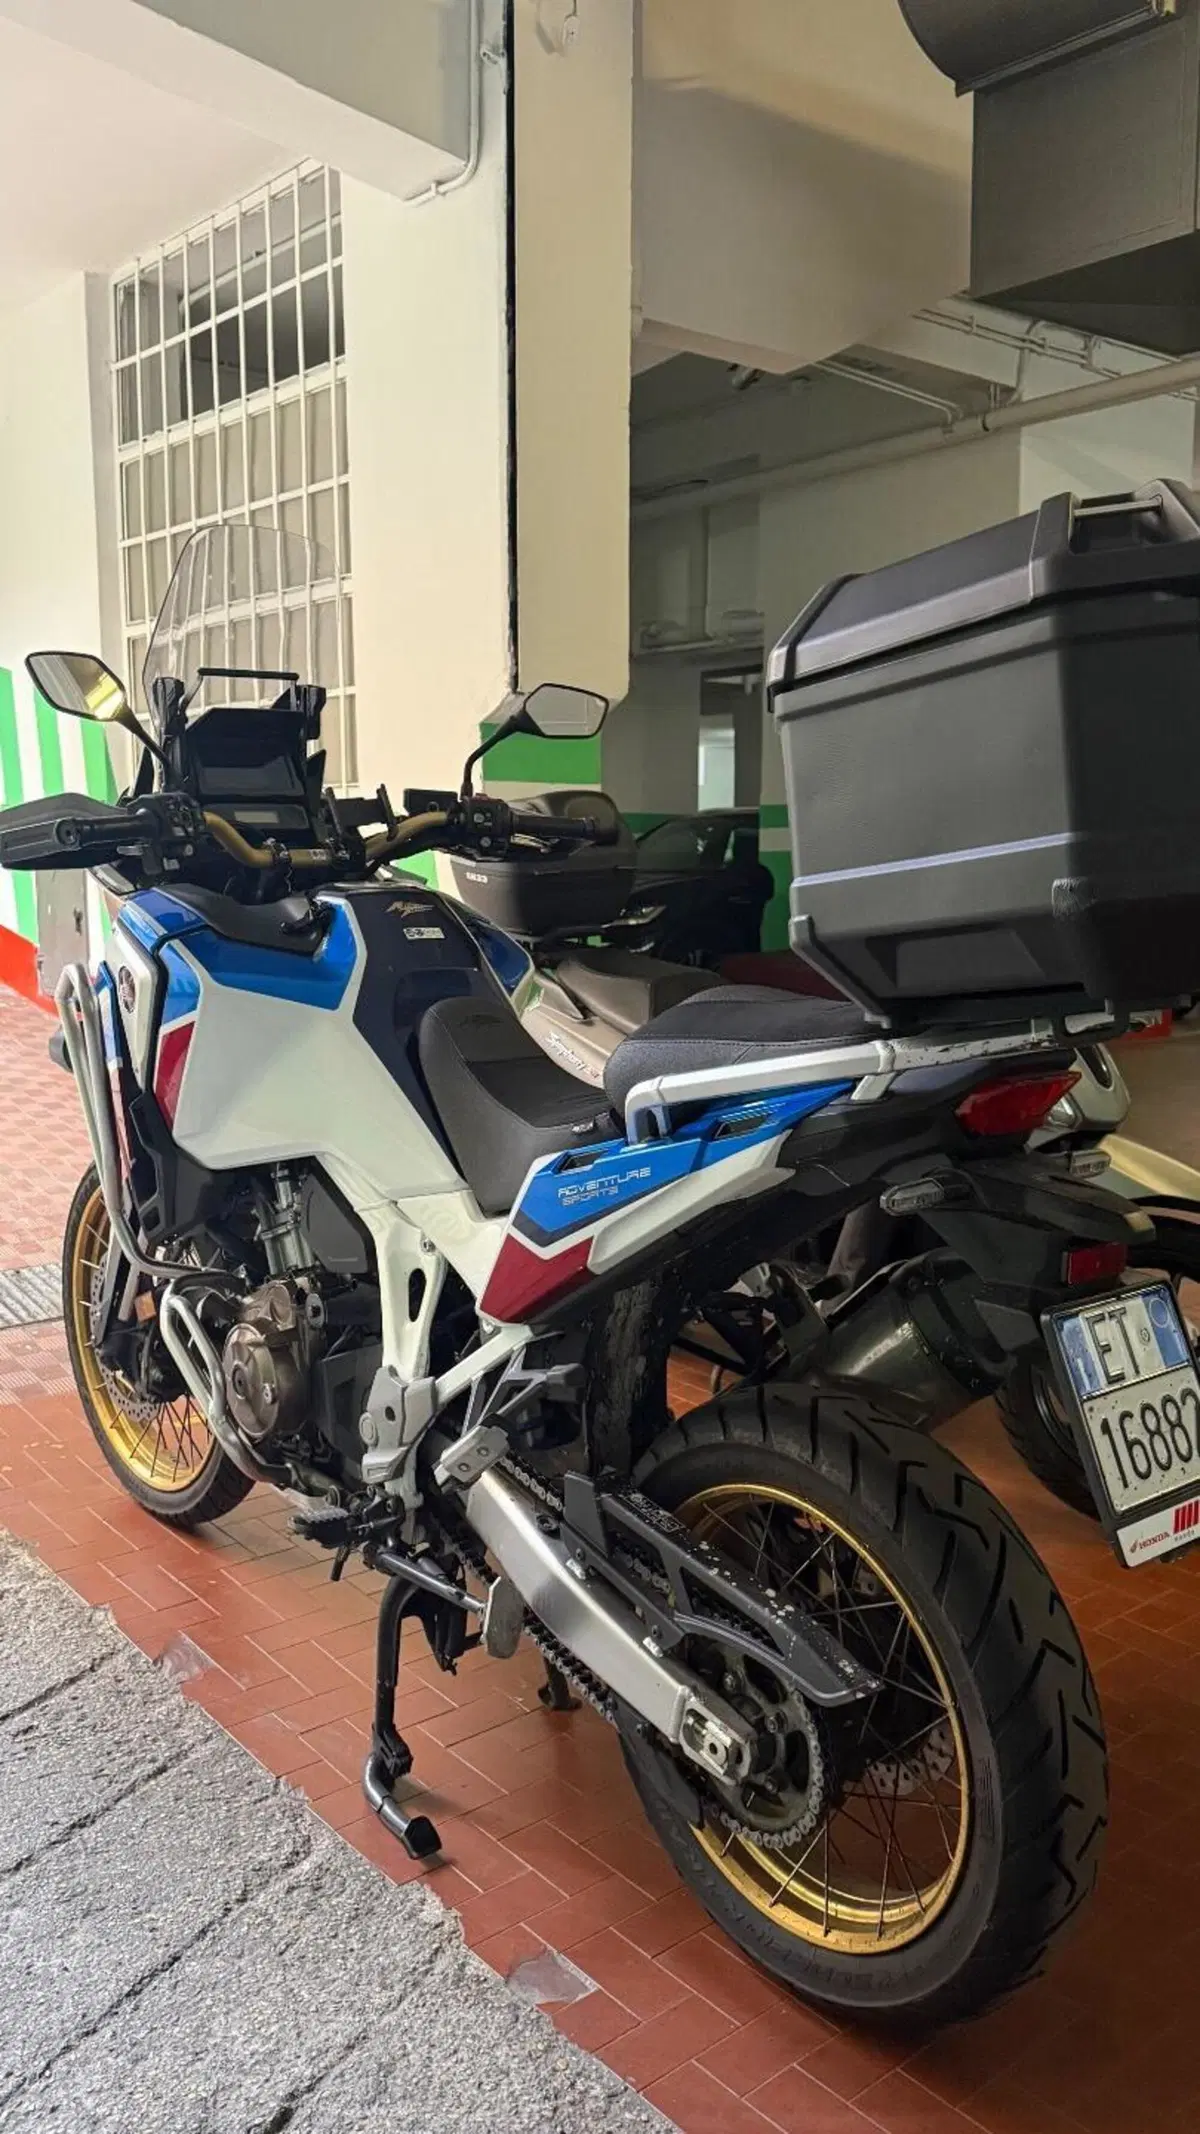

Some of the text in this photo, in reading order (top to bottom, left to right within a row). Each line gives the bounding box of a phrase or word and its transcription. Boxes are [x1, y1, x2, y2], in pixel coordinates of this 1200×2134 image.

[561, 1186, 619, 1207] SPORTS
[1086, 1305, 1140, 1385] ET
[1138, 1531, 1170, 1550] HONDA
